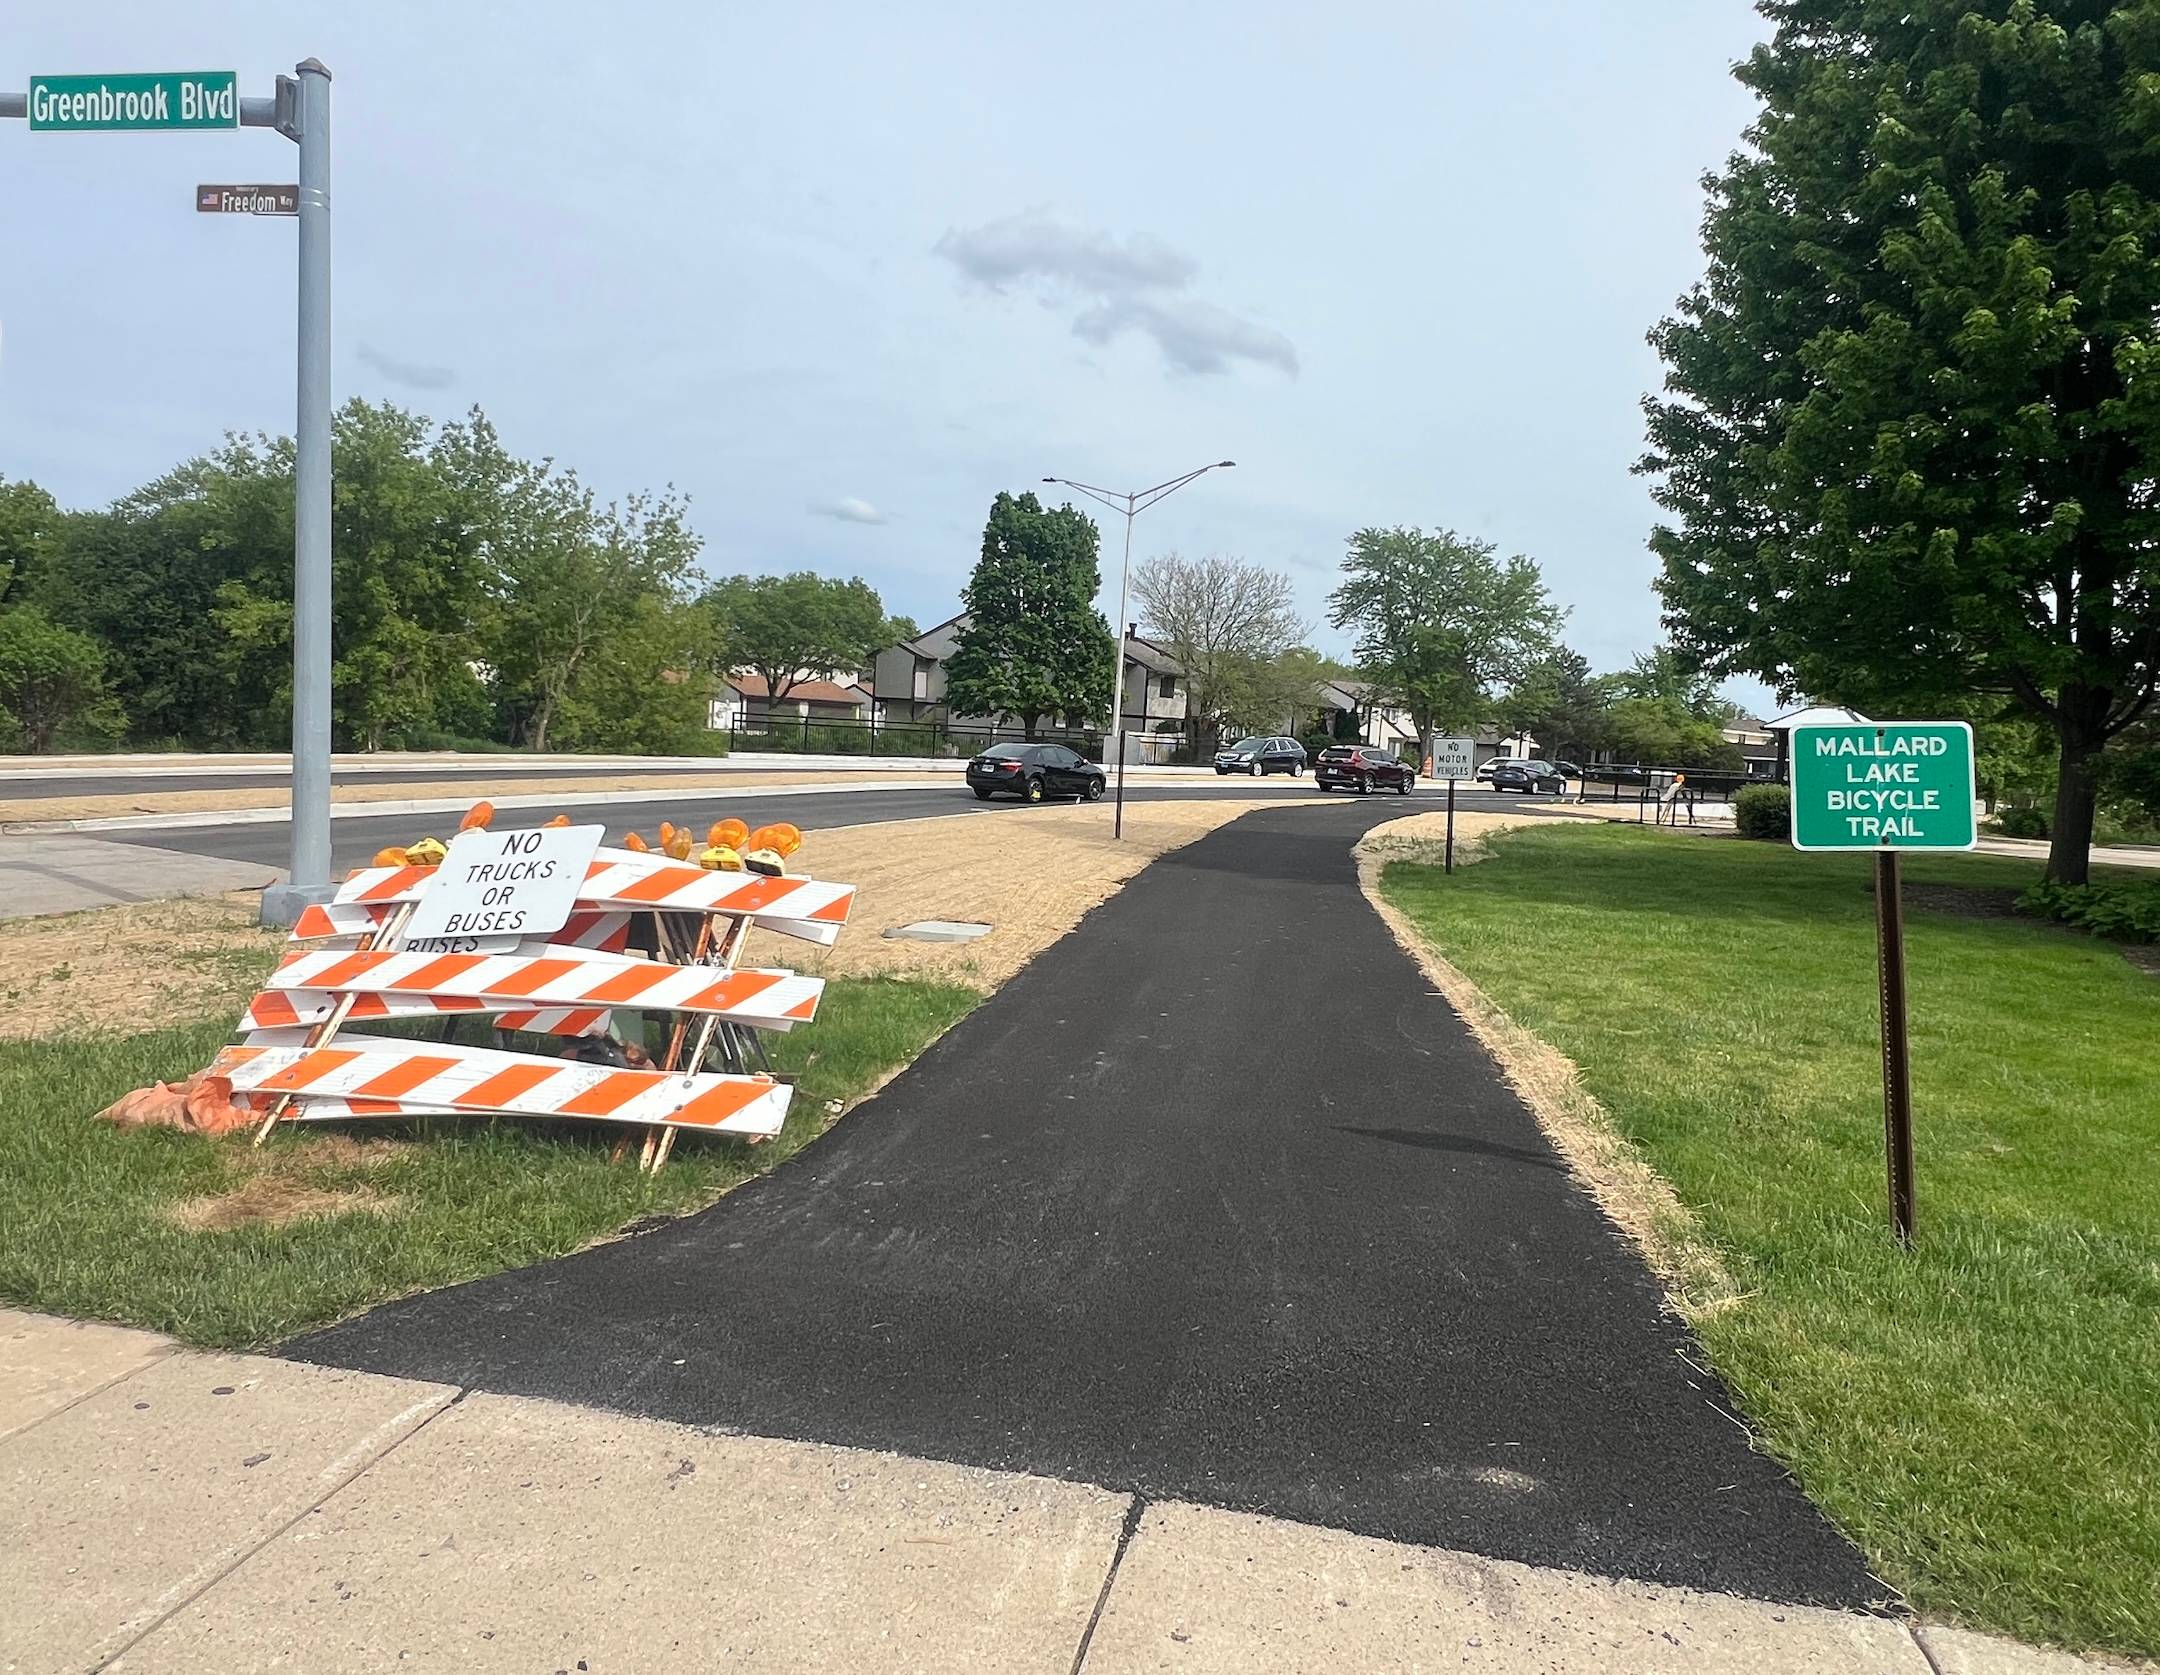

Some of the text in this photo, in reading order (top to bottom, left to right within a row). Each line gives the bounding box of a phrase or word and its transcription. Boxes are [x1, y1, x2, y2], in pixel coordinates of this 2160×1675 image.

[33, 82, 234, 122] Greenbrook Blvd
[221, 191, 276, 212] Freedom
[1448, 743, 1459, 751] NO
[1815, 736, 1948, 757] MALLARD
[1439, 755, 1467, 763] MOTOR
[1846, 763, 1920, 783] LAKE
[1827, 790, 1940, 811] BICYCLE
[1846, 816, 1925, 837] TRAIL
[501, 832, 543, 856] NO
[466, 860, 557, 884] TRUCKS
[482, 886, 515, 906] OR
[444, 910, 527, 933] BUSES
